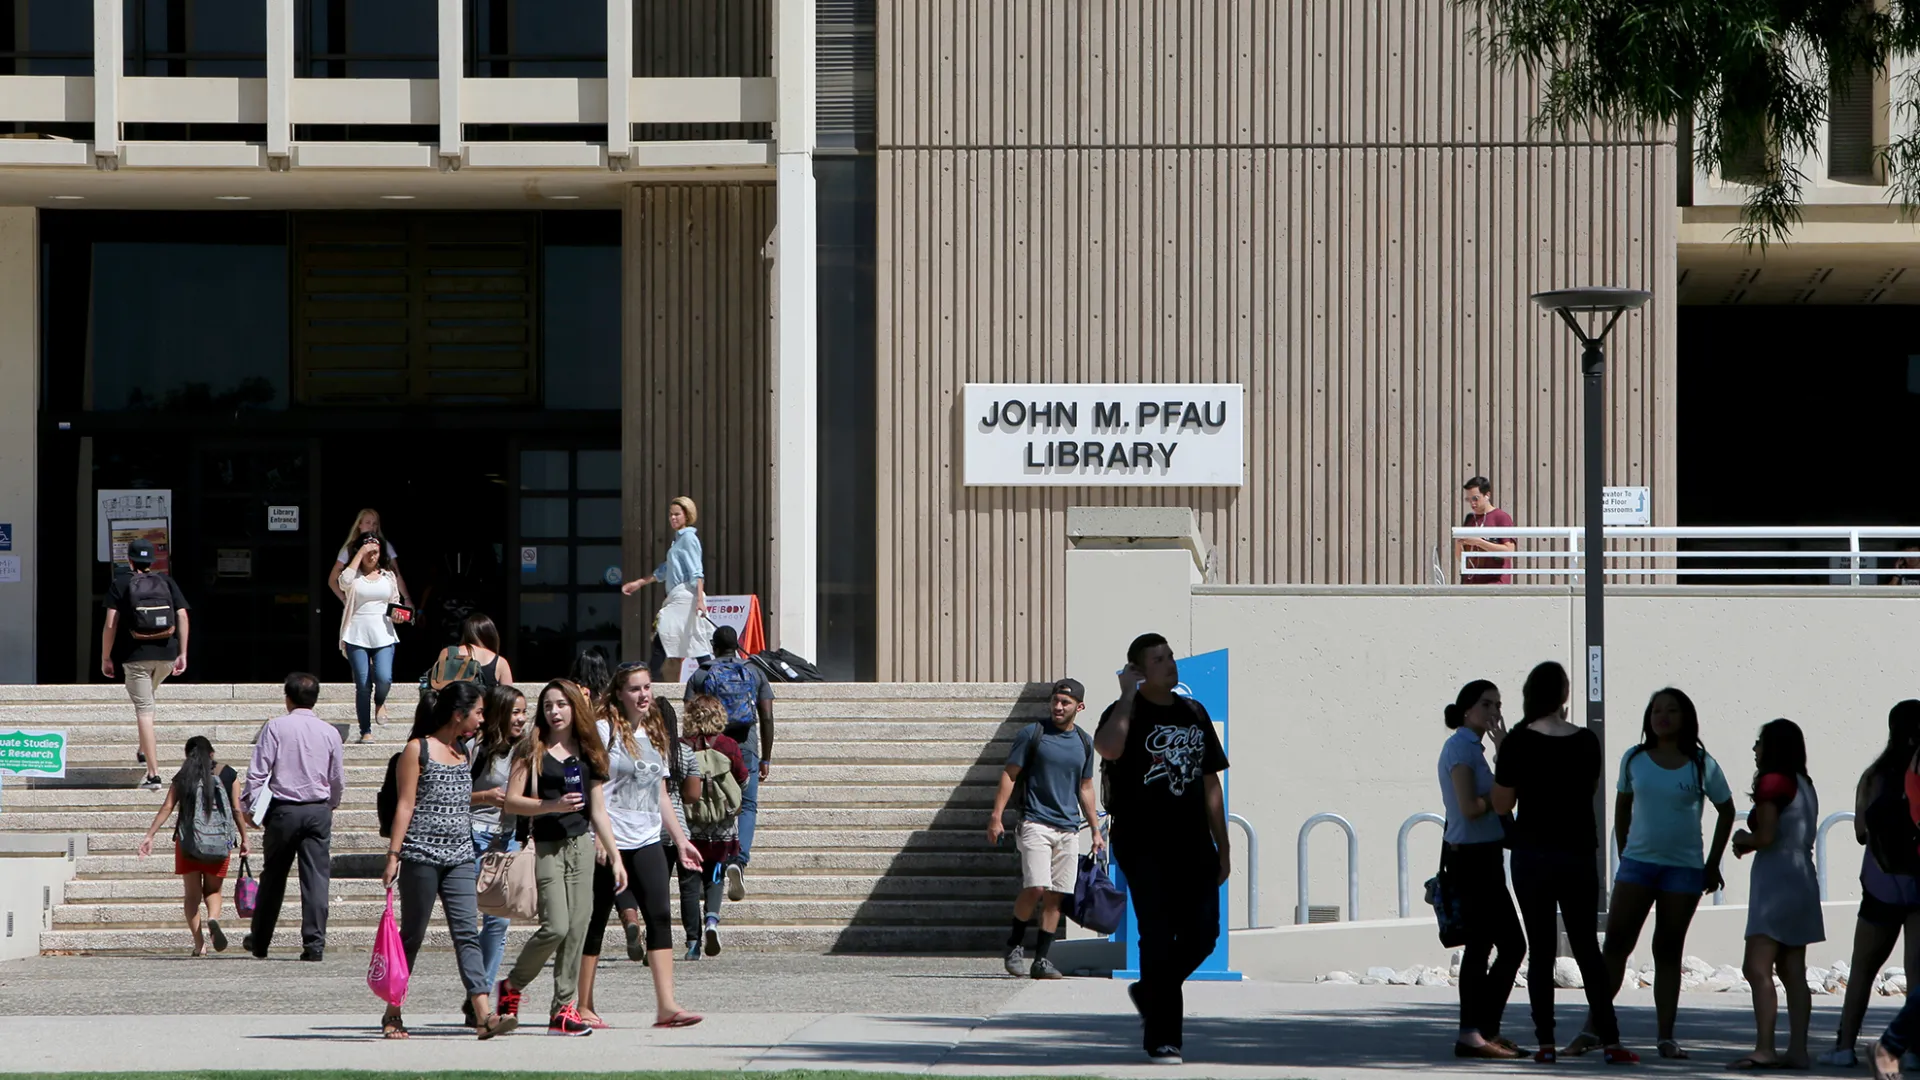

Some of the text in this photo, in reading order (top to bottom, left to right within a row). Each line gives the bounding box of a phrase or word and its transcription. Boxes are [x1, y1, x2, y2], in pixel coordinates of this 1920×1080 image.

[982, 400, 1227, 428] JOHN M. PFAU
[1026, 441, 1178, 468] LIBRARY
[273, 508, 295, 517] Library
[720, 605, 746, 614] BODY
[1145, 724, 1205, 753] Cali
[23, 739, 60, 749] Studies
[8, 749, 54, 759] Research
